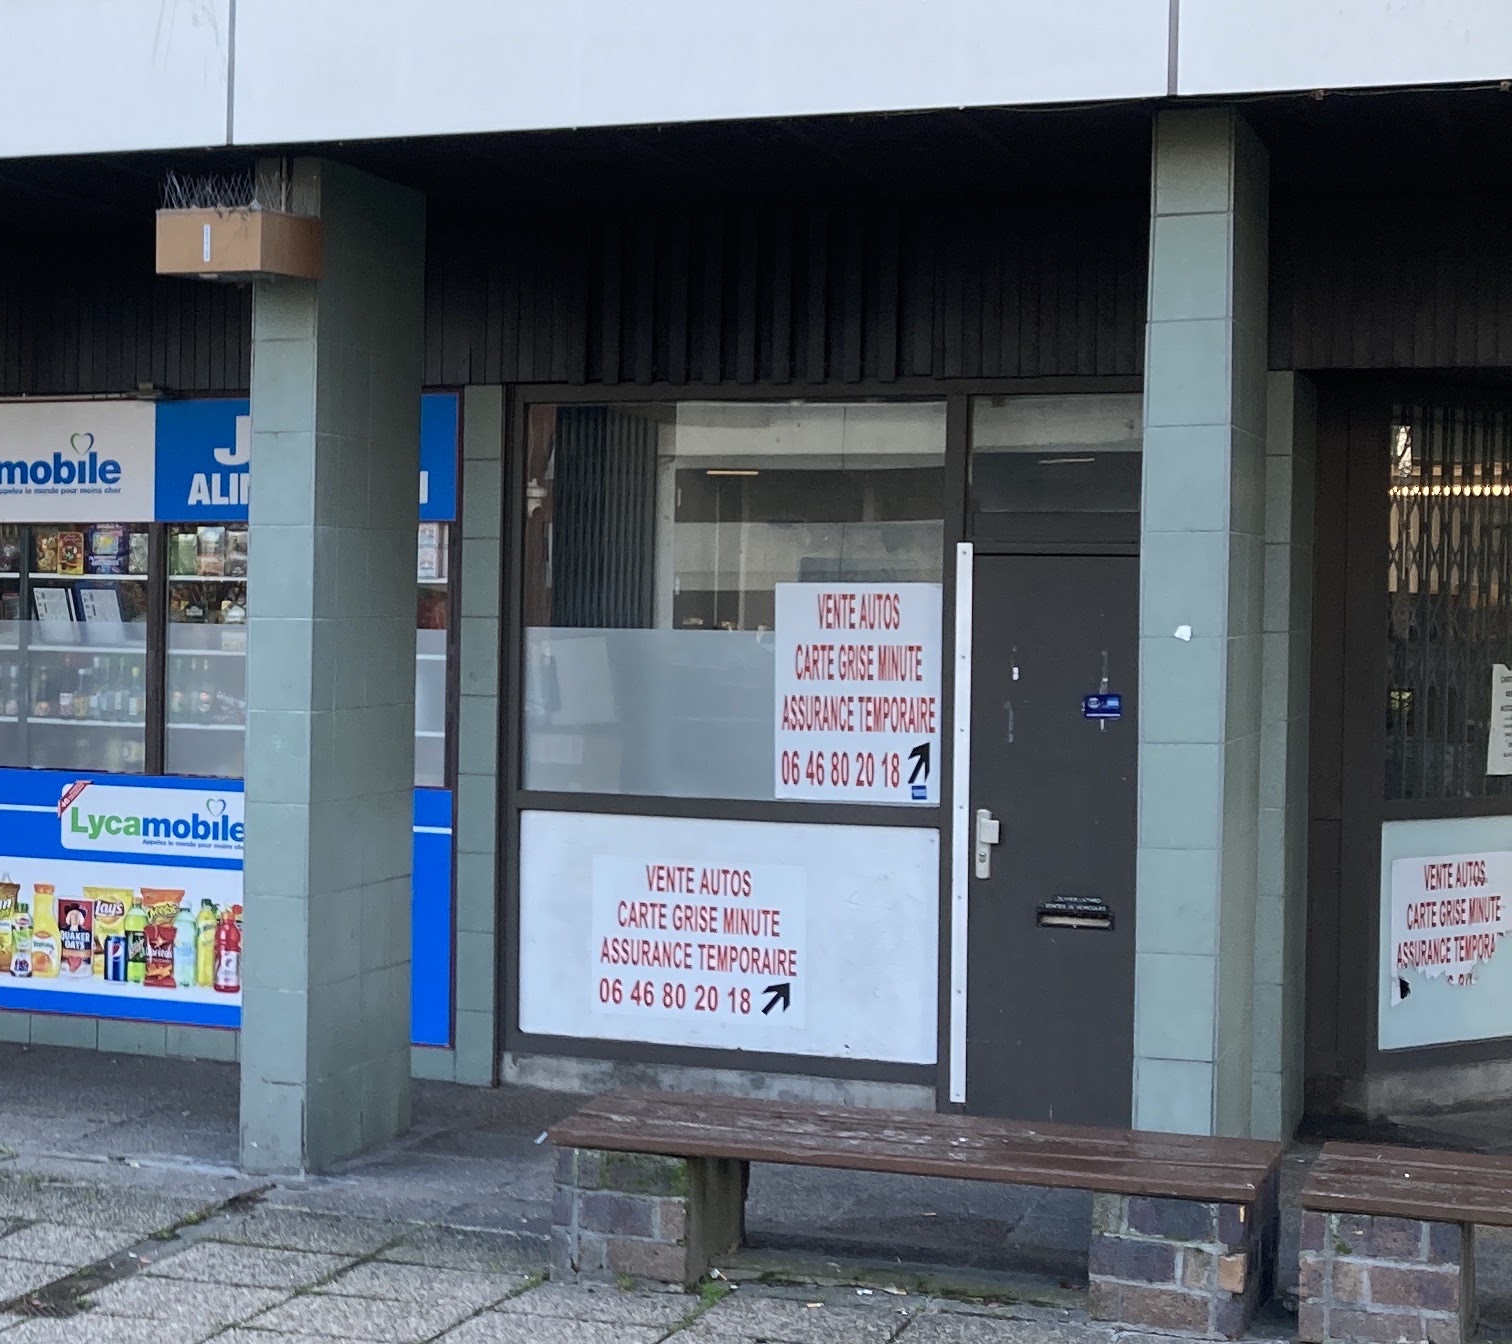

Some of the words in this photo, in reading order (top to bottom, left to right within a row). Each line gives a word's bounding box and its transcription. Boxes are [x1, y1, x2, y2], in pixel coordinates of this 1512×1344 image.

[818, 594, 856, 629] VENTE
[859, 594, 900, 630] AUTOS
[795, 644, 835, 680] CARTE
[839, 645, 874, 681] GRISE
[877, 645, 922, 681] MINUTE
[782, 695, 854, 732] ASSURANCE
[858, 696, 936, 733] TEMPORAIRE
[782, 750, 800, 785] 06
[805, 751, 825, 786] 46
[831, 751, 850, 787] 80
[855, 752, 875, 787] 20
[881, 753, 900, 788] 18
[71, 807, 244, 842] Lycamobile
[645, 864, 695, 894] VENTE
[700, 867, 752, 897] AUTOS
[1424, 863, 1453, 891] VENTE
[1455, 860, 1486, 888] AUTOS
[95, 901, 124, 916] Lay's
[618, 900, 667, 930] CARTE
[673, 904, 718, 933] GRISE
[723, 907, 780, 937] MINUTE
[1406, 901, 1437, 930] CARTE
[1440, 898, 1466, 927] GRISE
[1469, 896, 1501, 924] MINUTE
[600, 936, 693, 970] ASSURANCE
[698, 943, 797, 977] TEMPORAIRE
[1397, 937, 1451, 969] ASSURANCE
[599, 978, 622, 1004] 06
[630, 980, 654, 1006] 46
[663, 982, 686, 1009] 80
[695, 984, 718, 1011] 20
[728, 987, 751, 1015] 18
